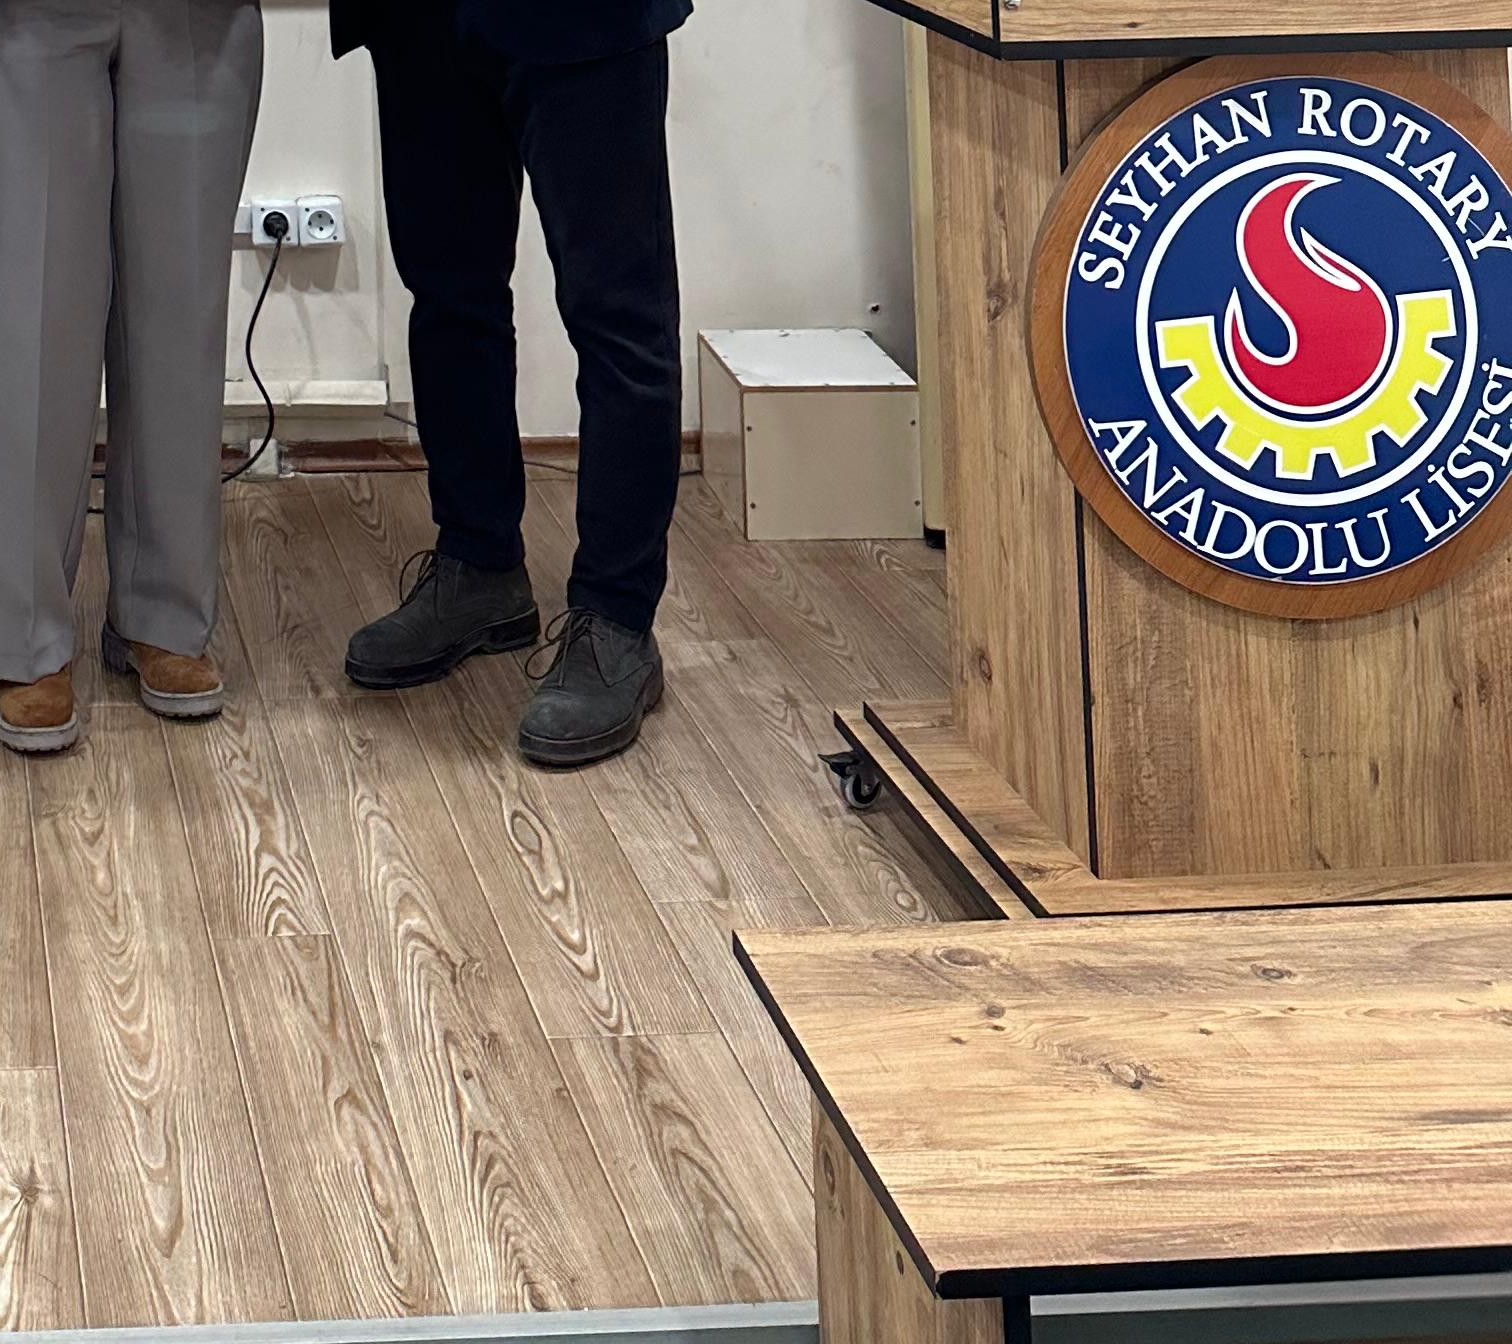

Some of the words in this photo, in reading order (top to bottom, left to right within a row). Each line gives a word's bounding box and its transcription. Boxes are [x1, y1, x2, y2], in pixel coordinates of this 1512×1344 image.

[1077, 88, 1272, 291] SEYHAN
[1297, 86, 1512, 262] ROTARY
[1088, 416, 1392, 577] ANADOLU
[1401, 357, 1512, 545] LİSESİ
